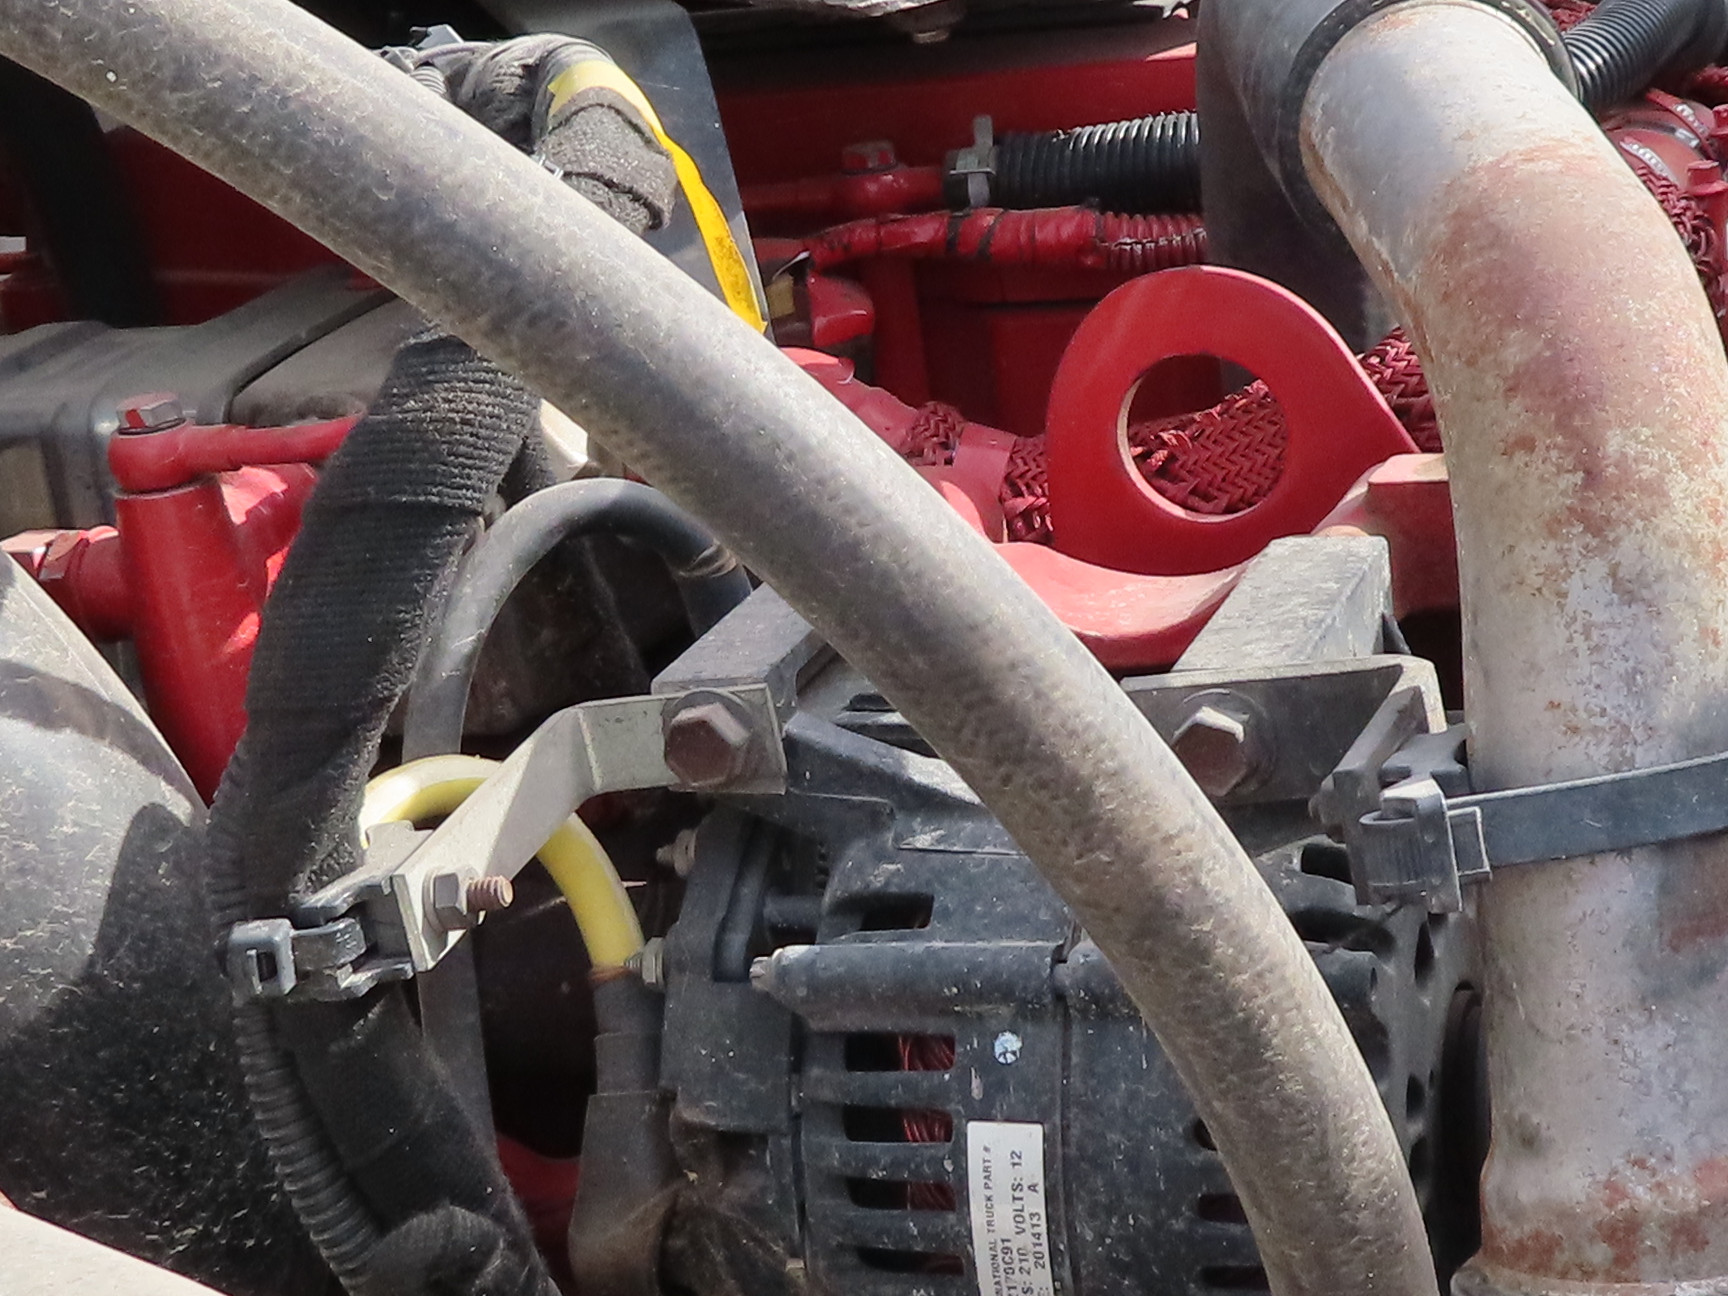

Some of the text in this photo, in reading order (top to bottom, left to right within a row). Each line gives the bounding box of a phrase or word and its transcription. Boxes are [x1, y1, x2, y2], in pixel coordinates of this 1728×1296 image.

[982, 1157, 993, 1190] PART
[1010, 1150, 1023, 1169] 12
[1027, 1183, 1039, 1194] A
[984, 1195, 995, 1234] TRUCK
[1011, 1177, 1026, 1235] VOLTS:
[1029, 1212, 1045, 1270] 201413
[1016, 1247, 1032, 1276] 210
